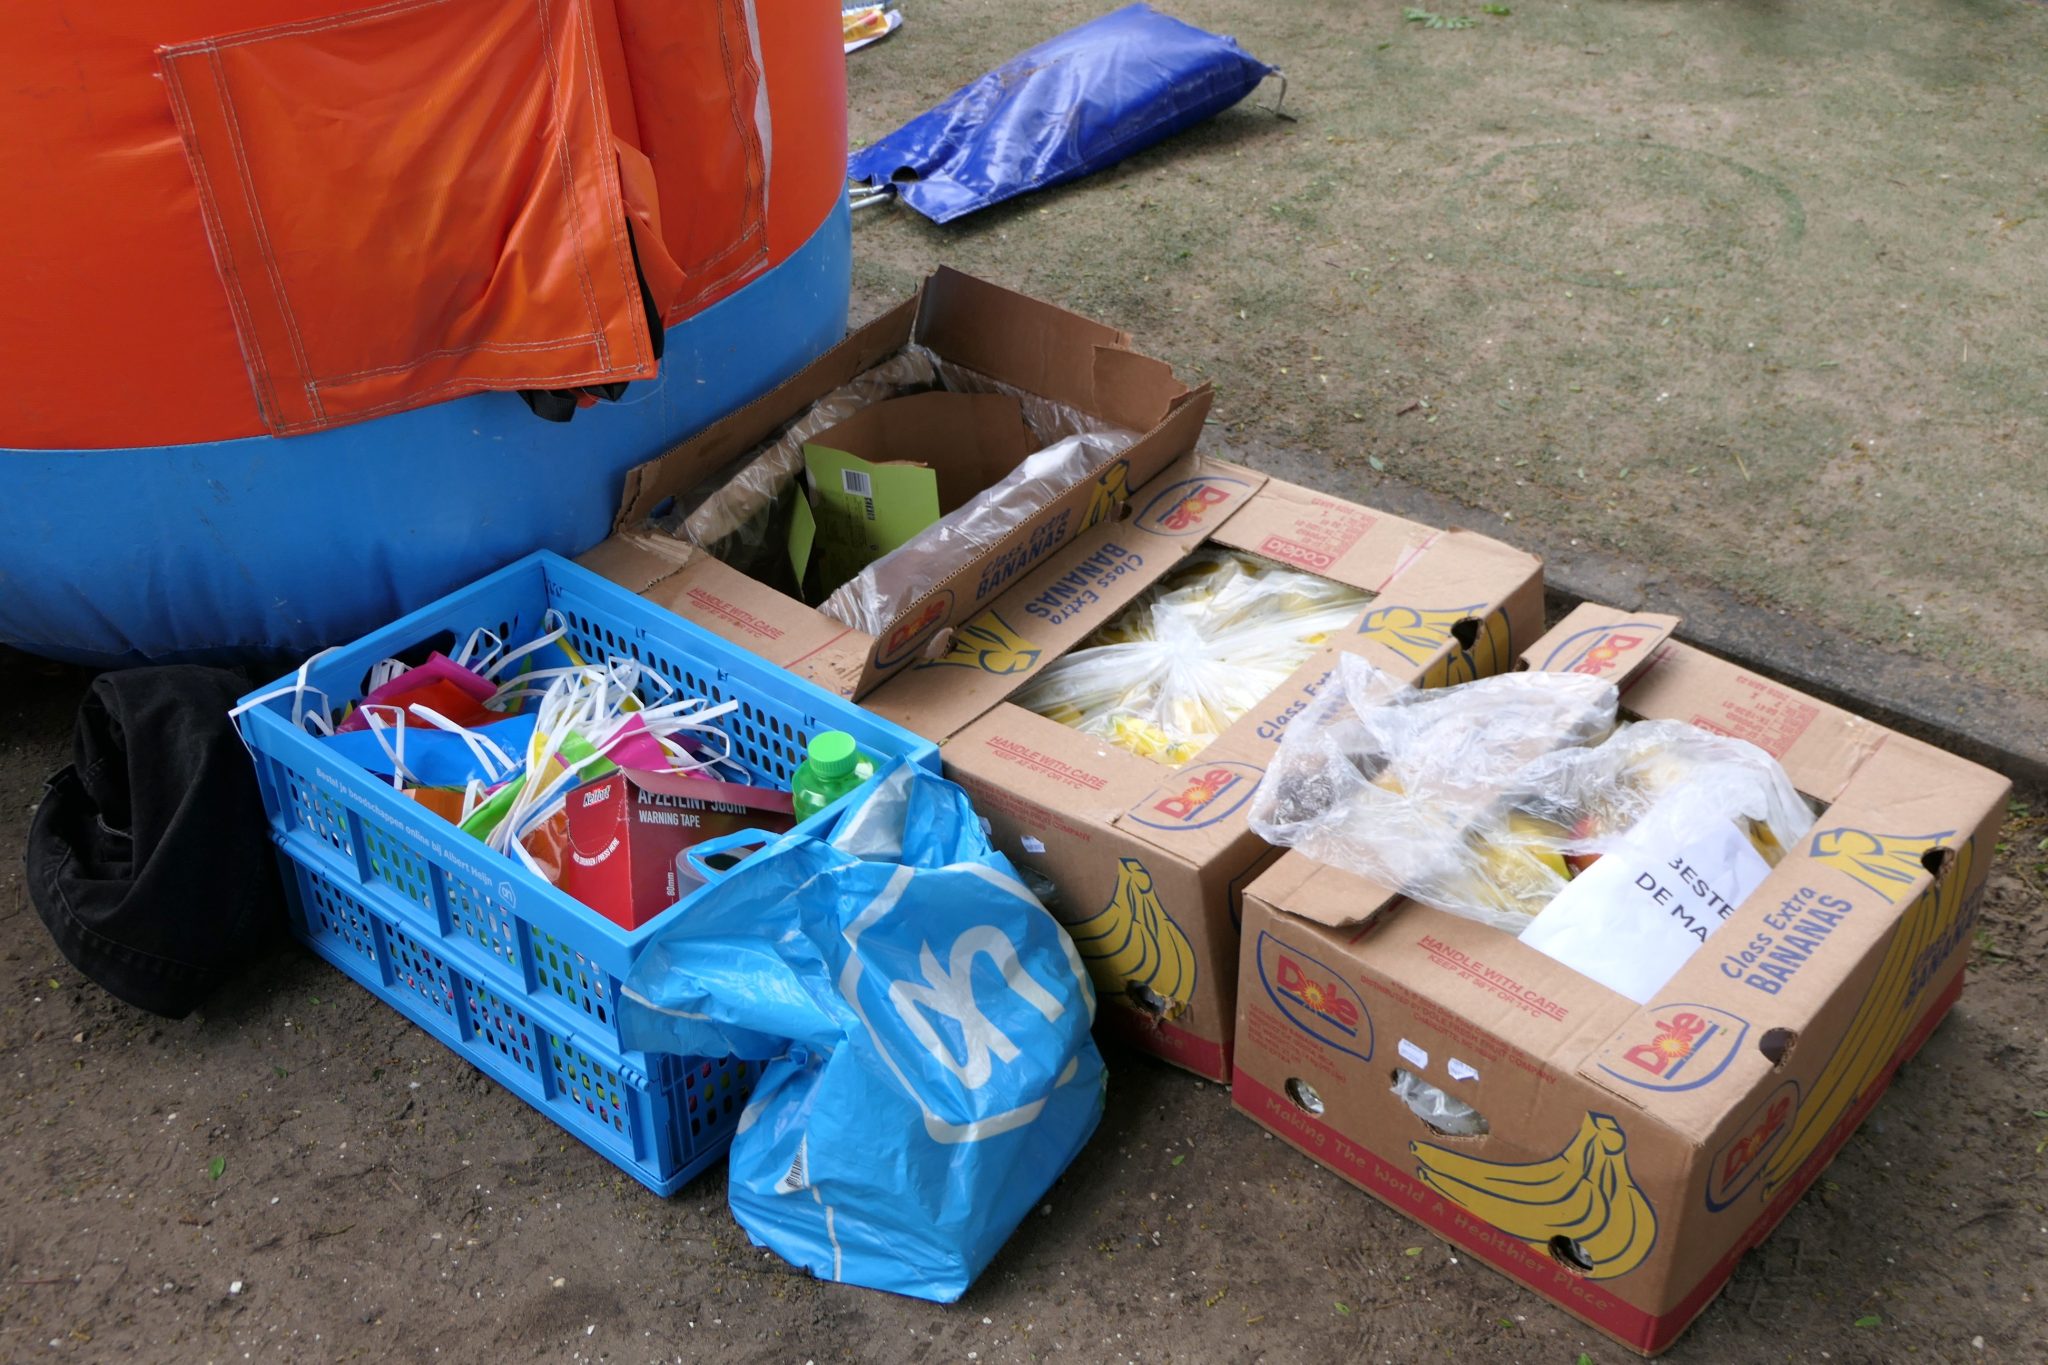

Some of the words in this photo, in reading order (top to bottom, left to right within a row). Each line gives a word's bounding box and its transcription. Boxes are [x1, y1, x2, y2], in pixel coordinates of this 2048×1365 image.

[1163, 485, 1231, 531] Dole
[976, 521, 1070, 601] BANANAS
[1096, 554, 1143, 588] Class
[1266, 539, 1331, 569] Codela
[1024, 542, 1128, 618] BANANAS
[691, 587, 731, 611] HANDLE
[732, 606, 757, 624] WITH
[753, 620, 785, 639] CARE
[1049, 589, 1099, 625] Extra
[1256, 700, 1308, 739] Class
[990, 736, 1041, 760] HANDLE
[1040, 754, 1072, 774] WITH
[1071, 769, 1108, 789] CARE
[1153, 769, 1233, 818] Dole
[349, 788, 404, 830] boodschappen
[406, 823, 430, 847] online
[431, 839, 442, 858] bij
[443, 849, 471, 873] Albert
[471, 866, 493, 887] Heijn
[639, 810, 679, 826] WARNING
[680, 813, 700, 828] TAPE
[608, 836, 620, 852] HERE
[667, 872, 675, 897] 80mm
[1634, 871, 1674, 906] DE
[1671, 904, 1708, 943] MA
[1720, 932, 1773, 980] Class
[1763, 886, 1817, 931] Extra
[1744, 894, 1853, 995] BANANAS
[1277, 955, 1359, 1026] Dole
[1422, 935, 1483, 971] HANDLE
[1483, 967, 1524, 993] WITH
[1522, 990, 1569, 1018] CARE
[1427, 954, 1458, 971] KEEP
[1457, 970, 1474, 981] AT
[1497, 991, 1515, 1003] OR
[1622, 1012, 1705, 1076] Dole
[1508, 1054, 1558, 1085] COMPANY
[1722, 1096, 1790, 1187] Dole
[1265, 1098, 1327, 1147] Making
[1334, 1139, 1367, 1168] The
[1374, 1165, 1425, 1202] World
[1432, 1202, 1446, 1216] A
[1454, 1213, 1546, 1274] Healthier
